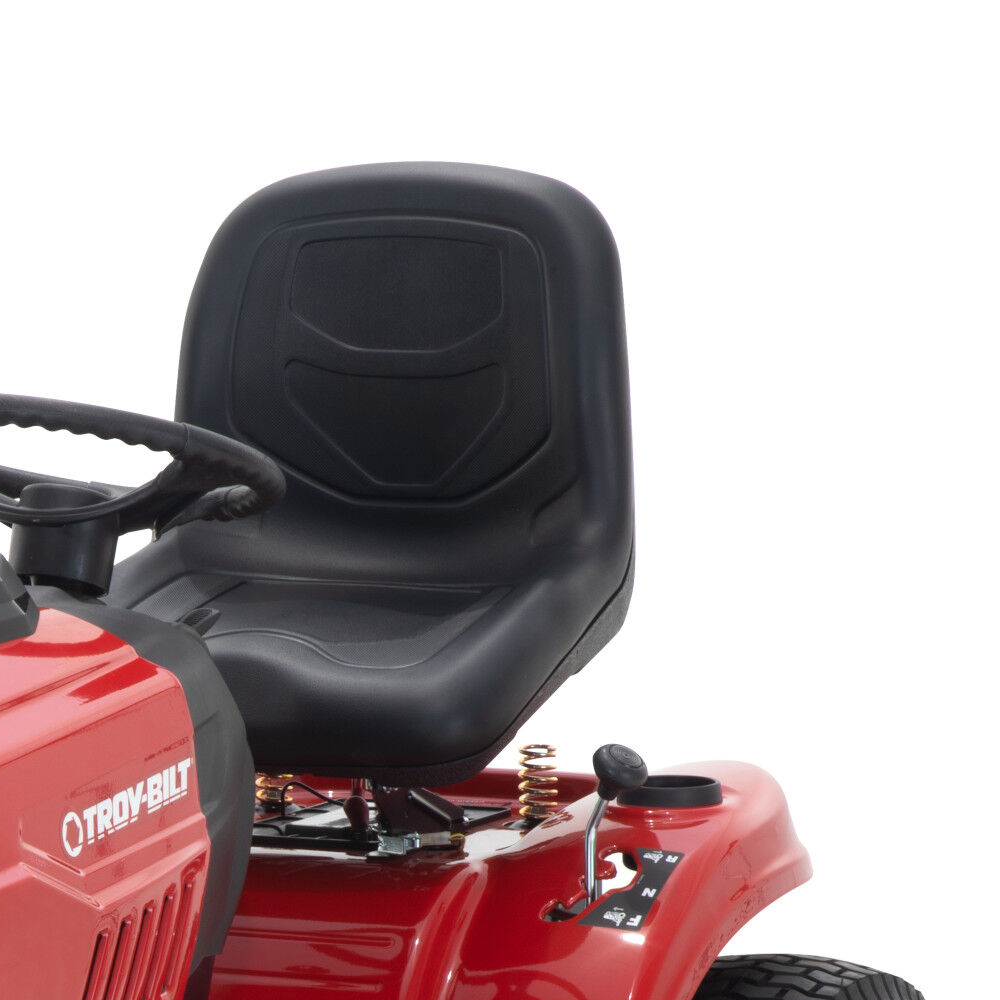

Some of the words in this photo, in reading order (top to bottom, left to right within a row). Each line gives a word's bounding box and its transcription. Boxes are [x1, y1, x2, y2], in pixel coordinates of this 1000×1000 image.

[83, 758, 191, 844] TROY-BILT
[665, 855, 679, 863] R
[641, 887, 657, 898] N
[626, 915, 642, 927] F
